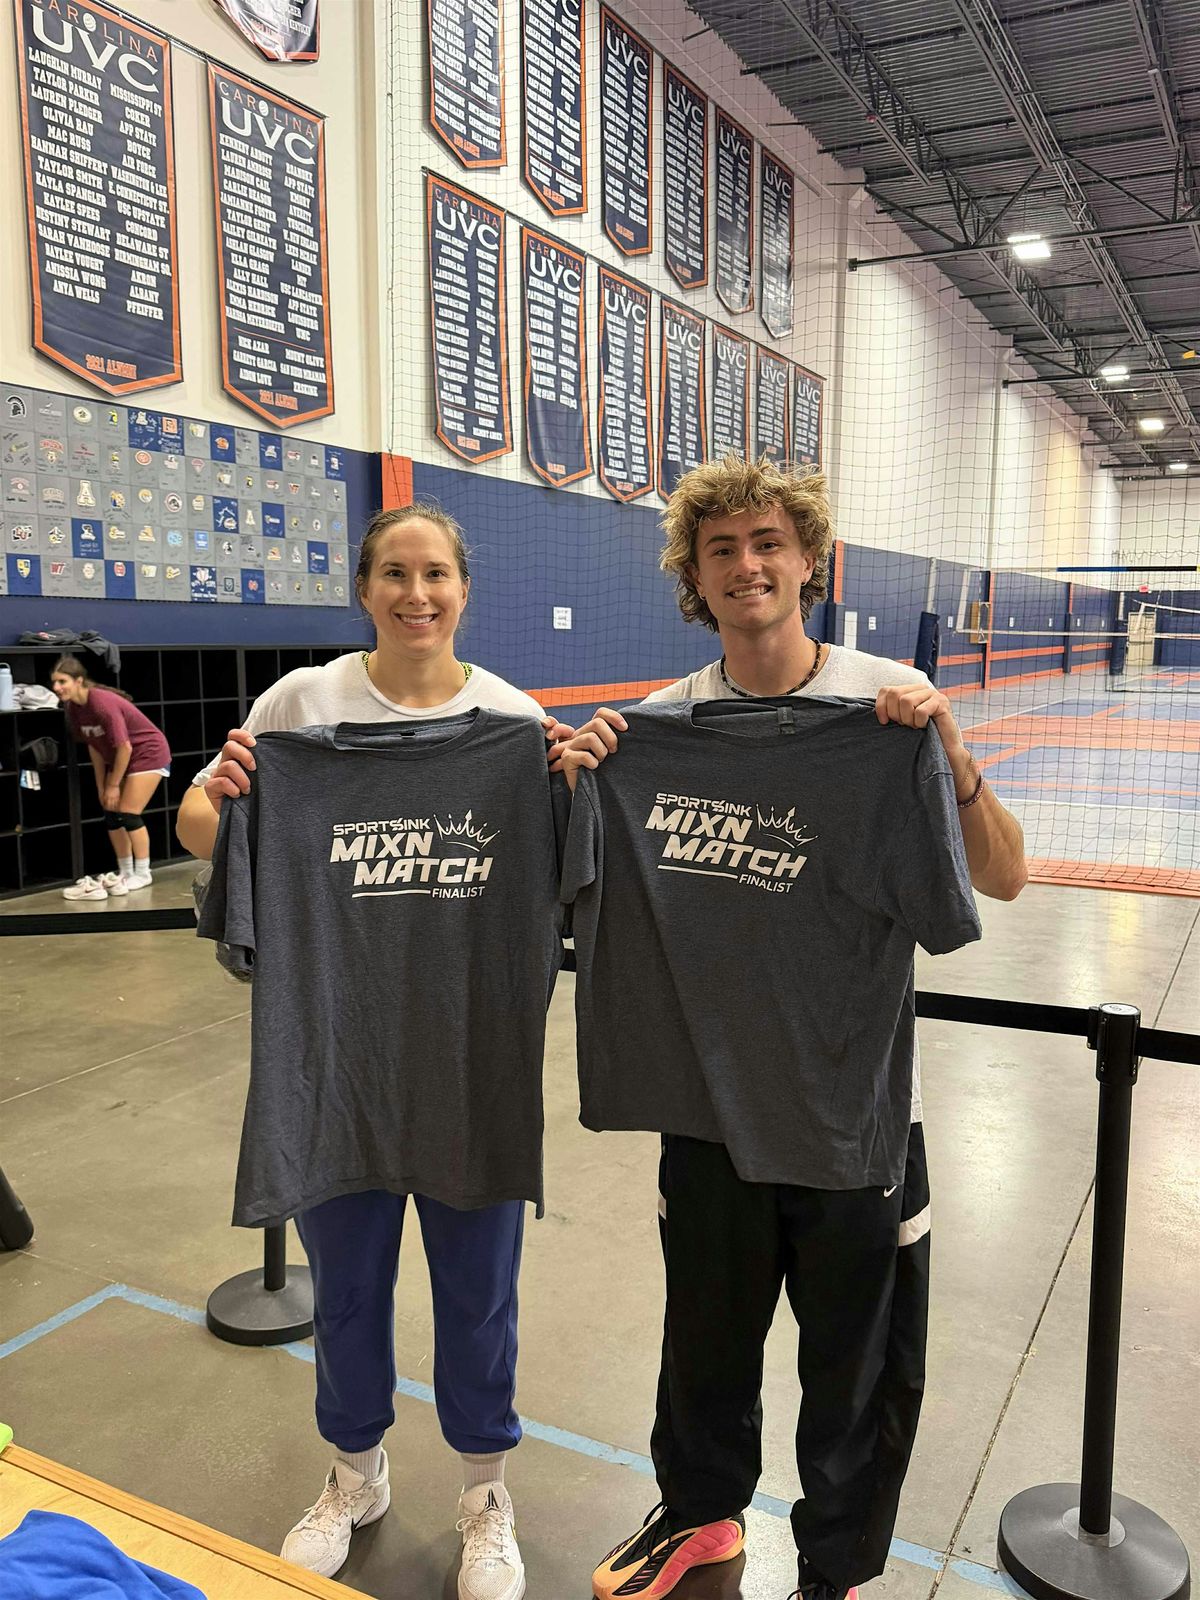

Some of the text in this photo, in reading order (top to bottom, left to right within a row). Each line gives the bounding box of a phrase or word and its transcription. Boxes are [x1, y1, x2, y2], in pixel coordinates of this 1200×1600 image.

[35, 0, 158, 62] AROLINA
[31, 4, 159, 93] UVC
[606, 27, 648, 80] UVC
[29, 48, 102, 90] LAUGHLIN MURRAY
[33, 68, 100, 106] TAYLOR PARKER
[110, 84, 163, 118] MISSISSIPPI ST
[31, 84, 103, 124] LAUREN PLEDGER
[124, 108, 151, 128] COKER
[219, 81, 315, 139] CAROLINA
[668, 82, 704, 126] UVC
[42, 107, 94, 136] OLIVIA RAU
[119, 121, 157, 147] APP STATE
[221, 96, 316, 165] UVC
[47, 125, 91, 152] MAC RUSS
[126, 141, 152, 160] BOYCE
[720, 126, 751, 165] UVC
[30, 136, 108, 175] HANNAH SHIFFERT
[122, 155, 157, 179] AIR FORCE
[37, 157, 103, 190] TAYLOR SMITH
[111, 166, 150, 192] WASHINGTON
[765, 165, 792, 199] UVC
[35, 172, 107, 208] KAYLA SPANGLER
[116, 184, 154, 208] CONNECTICUT
[43, 193, 100, 222] KAYLEE SPEES
[117, 201, 166, 229] USC UPSTATE
[226, 209, 252, 228] TAYLOR
[435, 188, 499, 229] CAROLINA
[35, 206, 111, 242] DESTINY STEWART
[125, 221, 158, 242] CONCORD
[436, 200, 499, 251] UVC
[37, 225, 111, 258] SARAH VANHOOSE
[116, 234, 169, 260] DELAWARE ST
[45, 261, 107, 289] ANISSIA WONG
[114, 249, 160, 274] BIRMINGHAM
[529, 250, 581, 293] UVC
[53, 280, 100, 304] ANYA WELLS
[129, 286, 159, 304] ALBANY
[131, 271, 157, 288] AKRON
[126, 301, 164, 321] PFEIFFER
[604, 288, 647, 325] UVC
[665, 319, 701, 351] UVC
[717, 341, 747, 370] UVC
[761, 361, 787, 387] UVC
[797, 381, 821, 404] UVC
[645, 805, 753, 843] MIXN
[329, 831, 434, 863] MIXN
[662, 834, 808, 879] MATCH
[353, 857, 494, 887] MATCH
[739, 873, 793, 894] FINALIST
[431, 886, 486, 899] FINALIST
